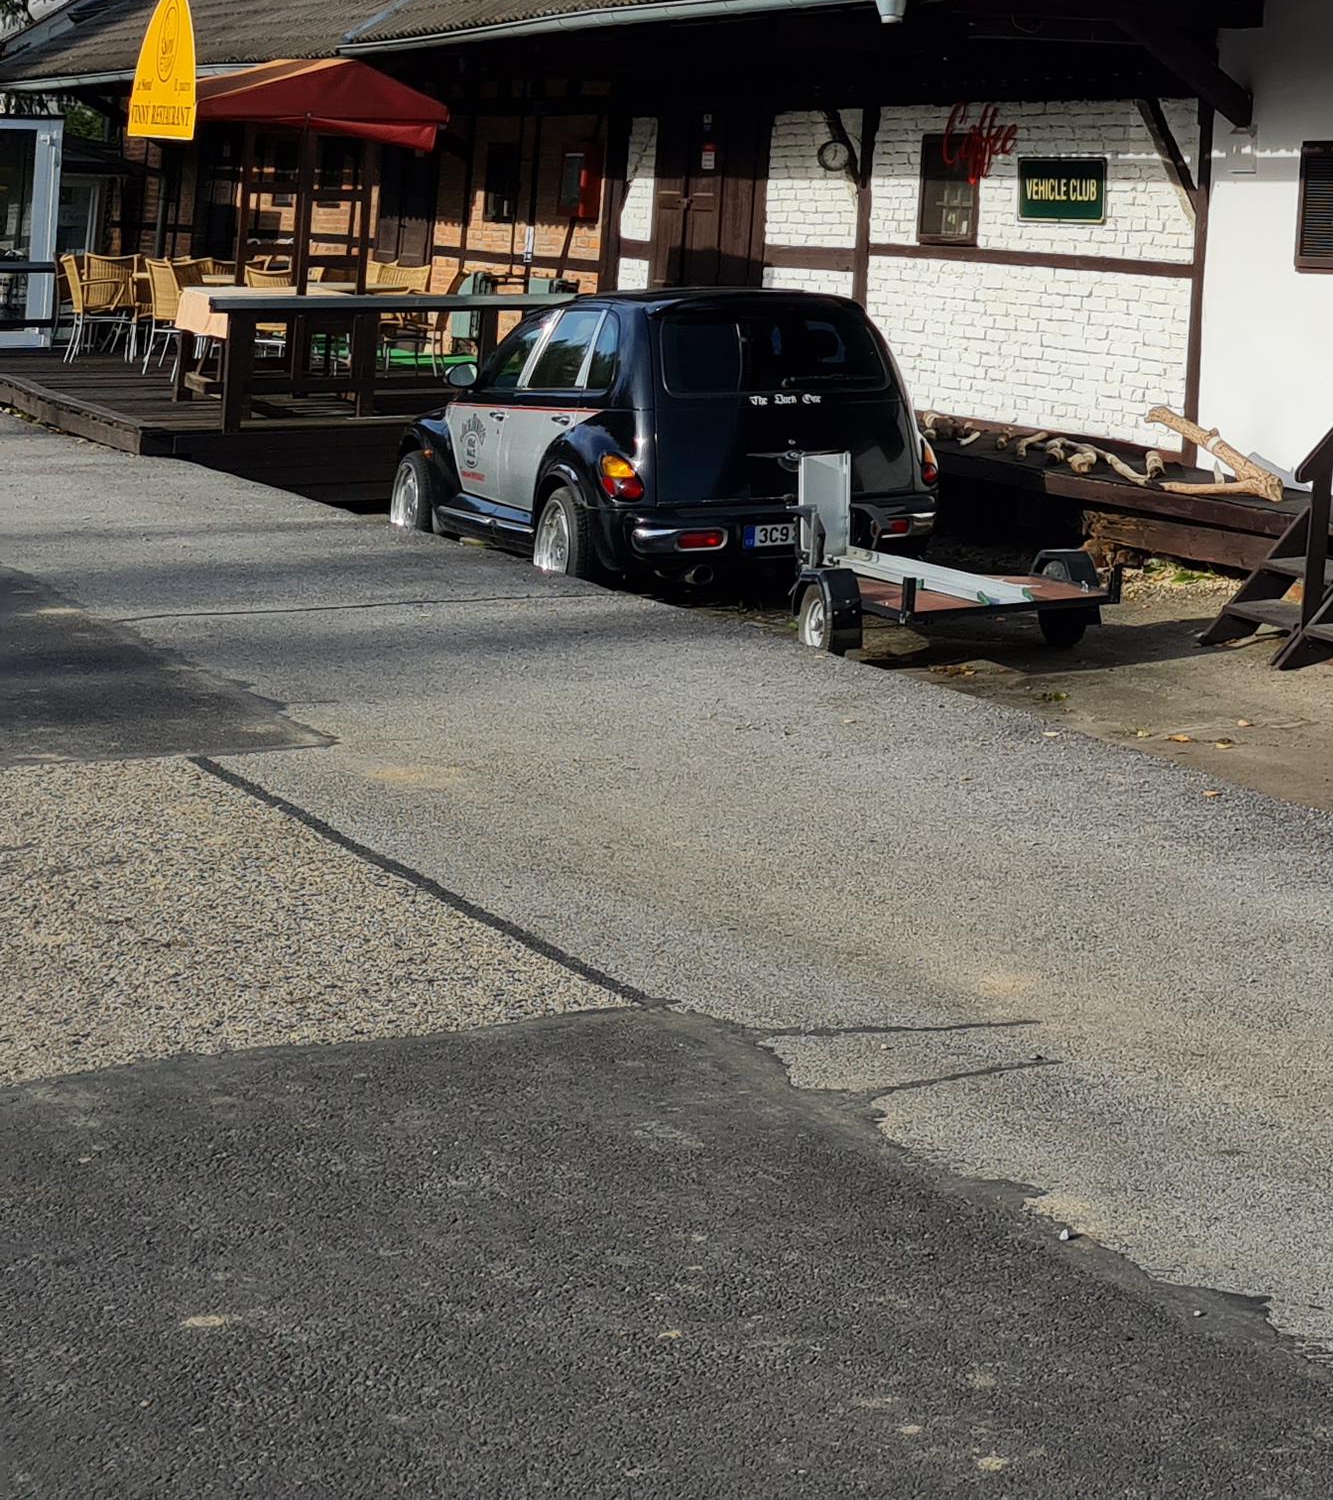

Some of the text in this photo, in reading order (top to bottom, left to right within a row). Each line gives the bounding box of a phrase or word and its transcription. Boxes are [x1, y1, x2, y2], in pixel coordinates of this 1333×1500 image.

[943, 101, 1018, 185] Coffee
[1026, 178, 1097, 201] VEHICLE CLUB
